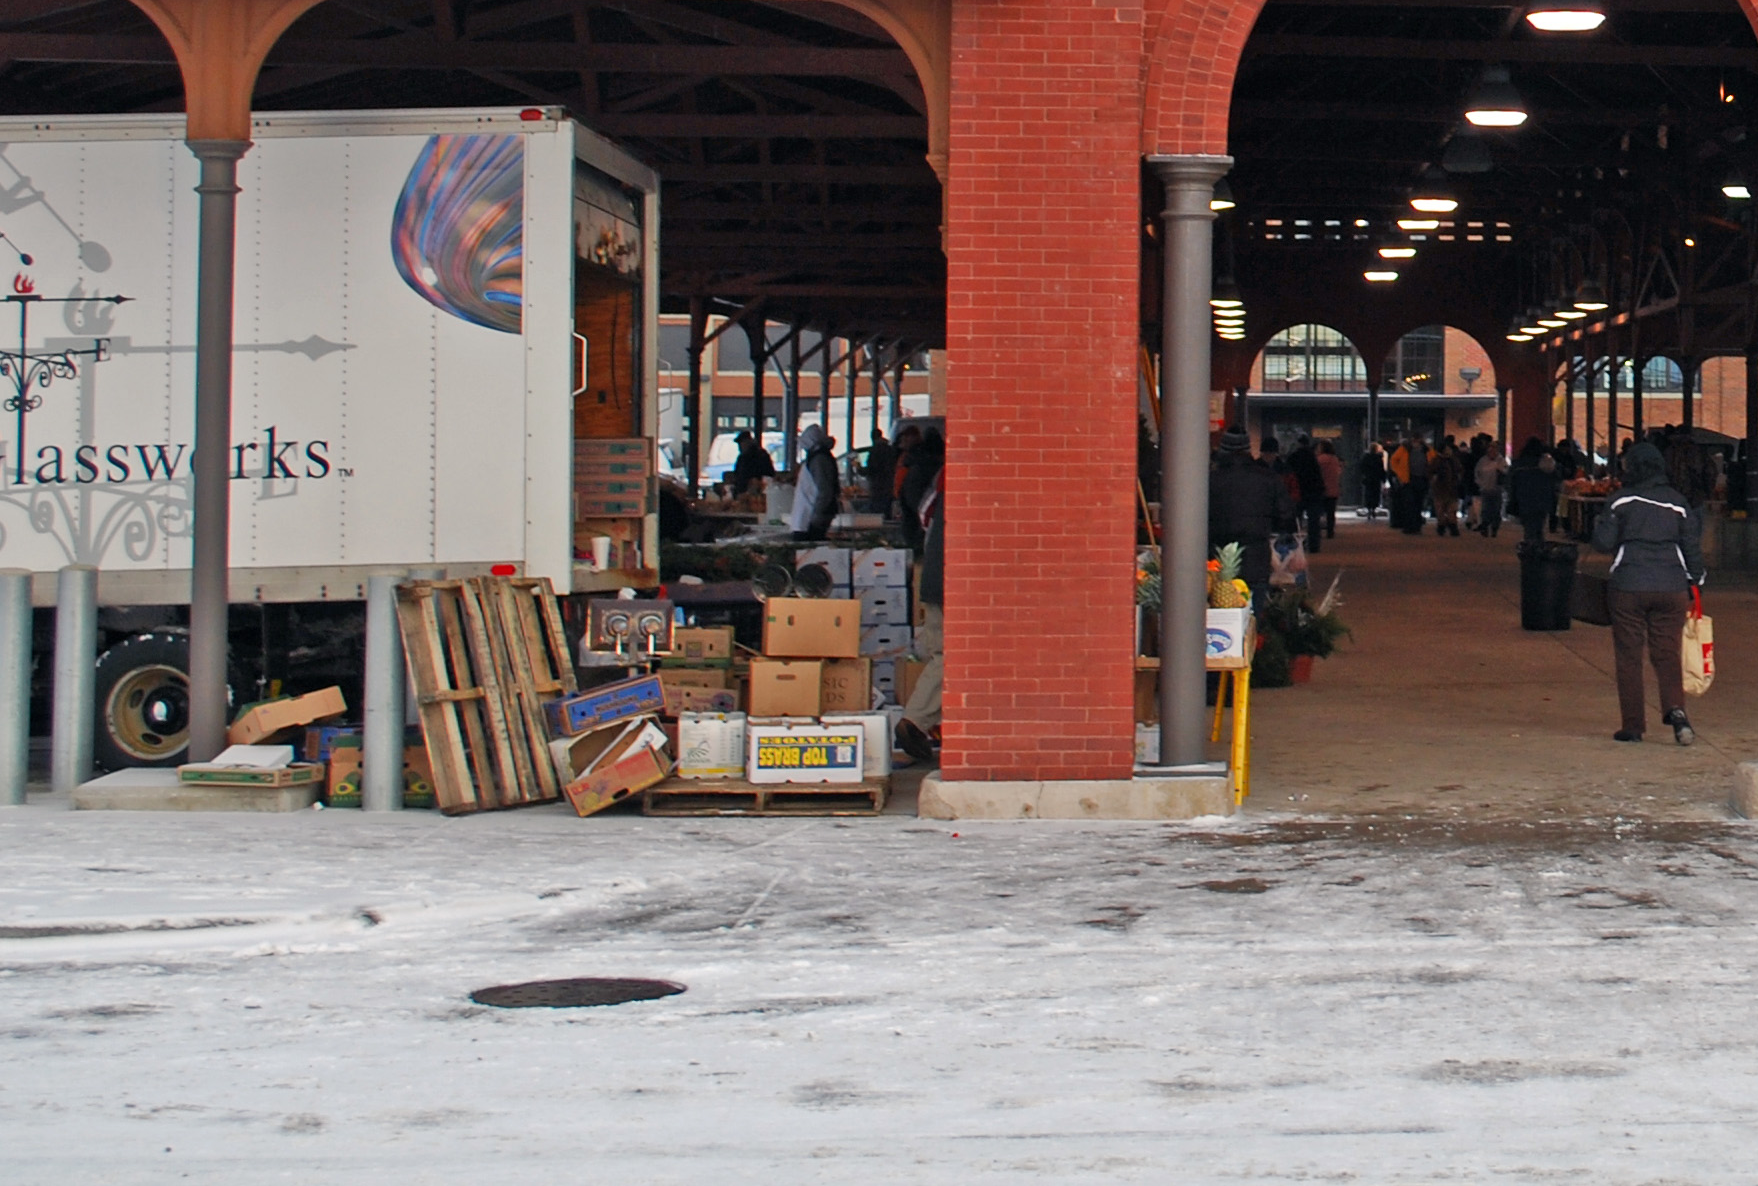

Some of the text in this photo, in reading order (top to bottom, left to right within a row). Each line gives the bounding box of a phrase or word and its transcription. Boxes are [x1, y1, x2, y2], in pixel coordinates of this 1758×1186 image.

[759, 736, 856, 745] POTATOES
[758, 747, 828, 767] TOP BRASS
